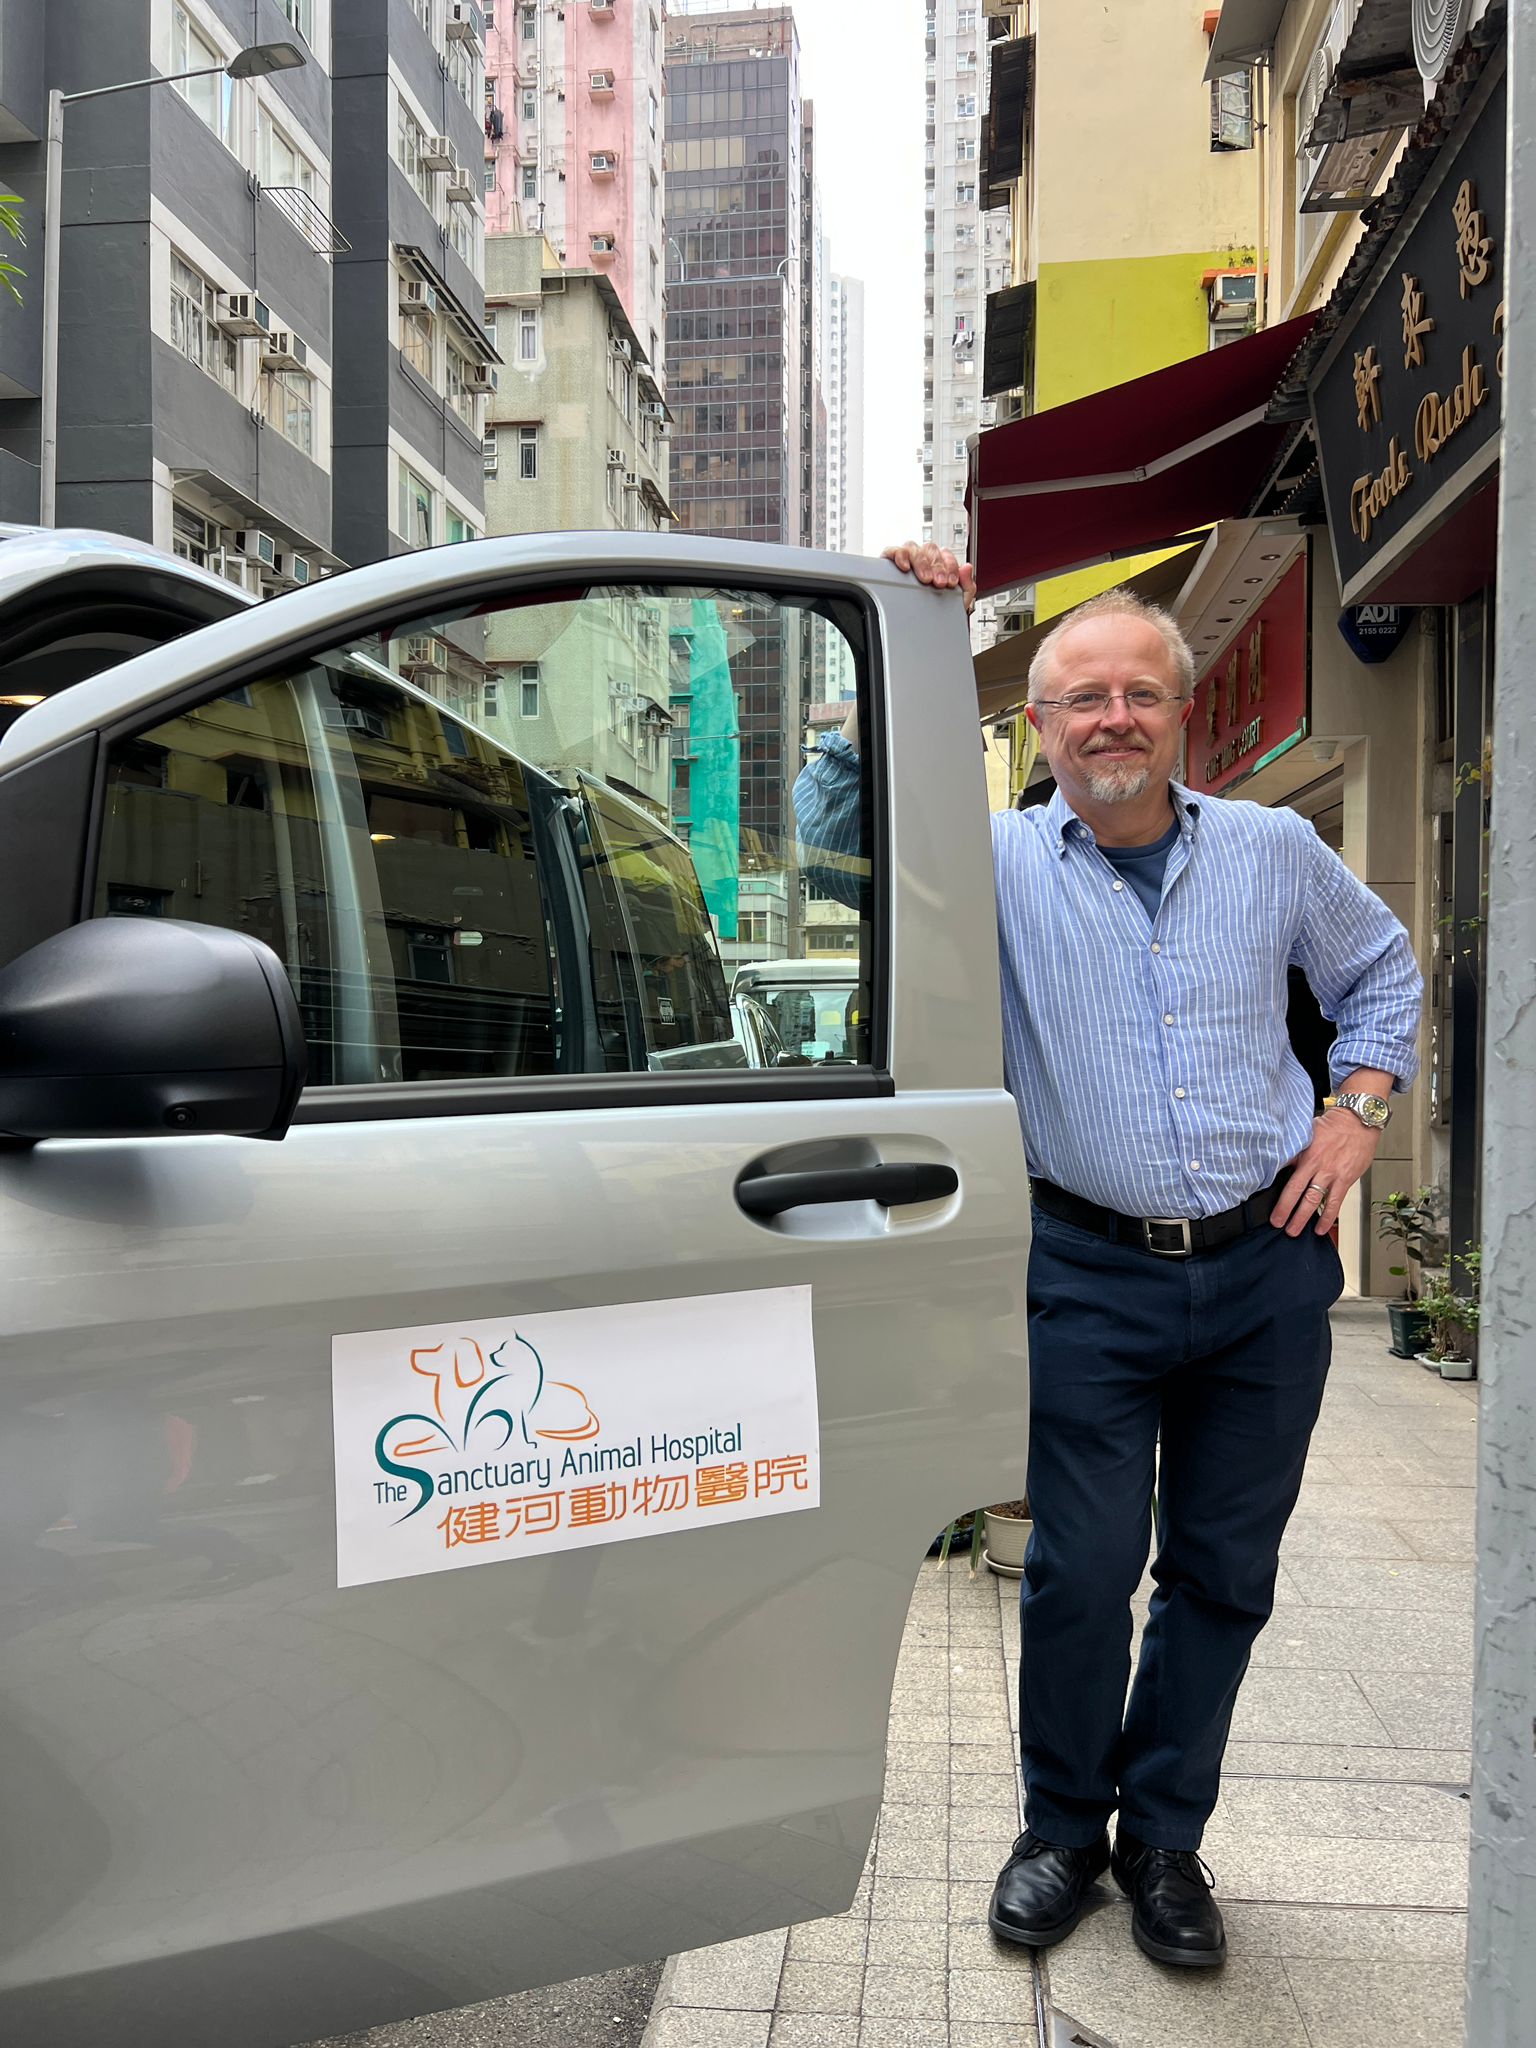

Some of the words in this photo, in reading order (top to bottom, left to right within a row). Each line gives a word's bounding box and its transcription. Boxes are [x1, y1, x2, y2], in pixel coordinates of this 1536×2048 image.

[1351, 434, 1413, 542] Fools
[1415, 343, 1490, 464] Rush
[1357, 605, 1396, 623] ADT
[1359, 627, 1377, 635] 2155
[1379, 626, 1397, 634] 0222
[1237, 716, 1261, 757] COURT
[561, 1437, 643, 1478] Animal
[652, 1423, 743, 1466] Hospital
[375, 1414, 551, 1527] Sanctuary
[374, 1481, 407, 1505] The
[437, 1453, 809, 1550] 健河動物醫院
